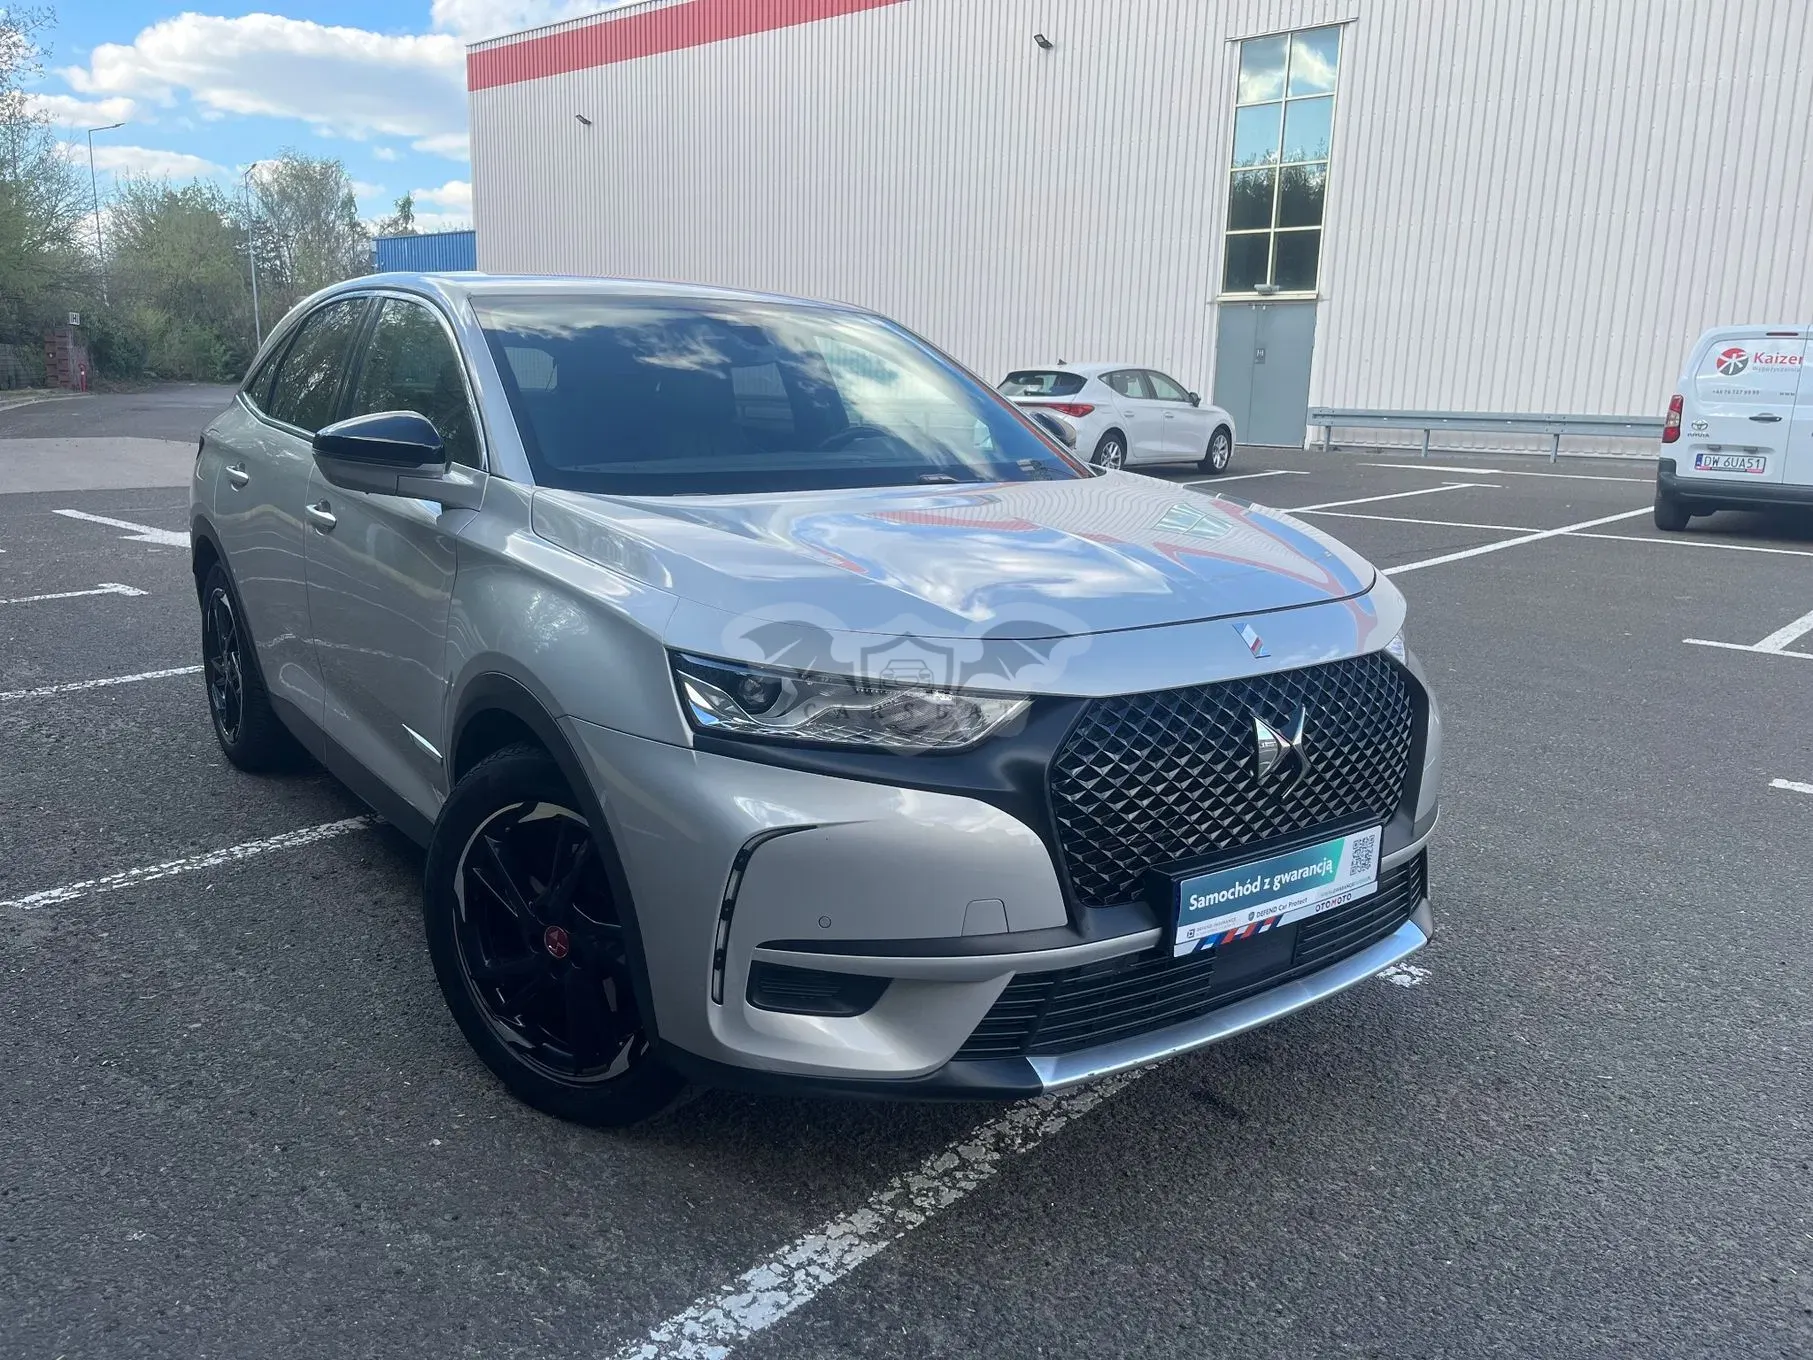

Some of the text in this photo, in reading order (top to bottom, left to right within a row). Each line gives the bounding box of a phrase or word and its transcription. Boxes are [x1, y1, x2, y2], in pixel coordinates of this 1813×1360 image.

[1753, 352, 1804, 365] Kaizer
[1703, 456, 1720, 467] DW
[1723, 457, 1761, 469] 6UA51
[1188, 875, 1262, 911] Samochód
[1263, 878, 1271, 890] z
[1272, 857, 1333, 891] gwarancją
[1256, 897, 1308, 918] DEFEND Car Protect
[1315, 893, 1352, 912] OTOMOTO
